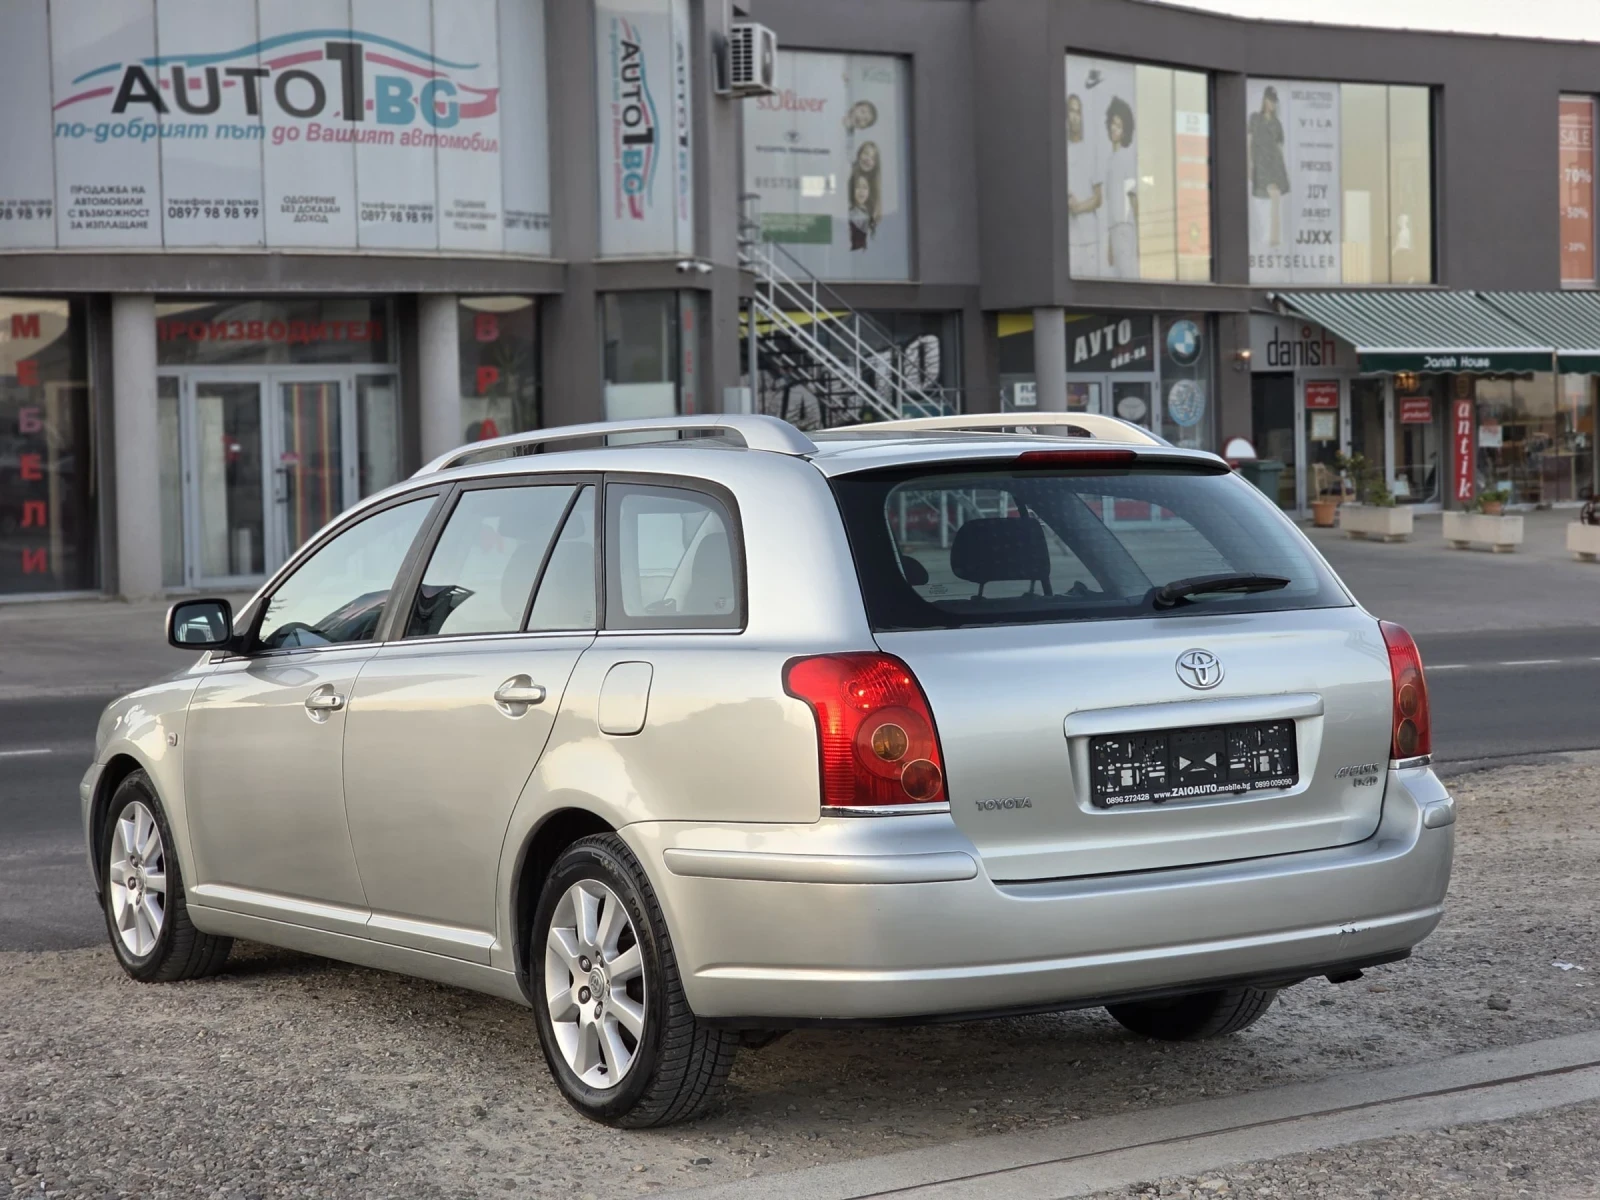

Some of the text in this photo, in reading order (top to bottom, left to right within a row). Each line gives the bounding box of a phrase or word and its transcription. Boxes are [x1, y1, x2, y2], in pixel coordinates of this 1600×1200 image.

[54, 117, 499, 153] по-добрият път до Вашият автомобил
[1560, 129, 1590, 146] SALE
[70, 185, 146, 195] ПРОДАЖБА НА
[73, 196, 143, 207] АВТОМОБИЛИ
[78, 208, 150, 218] ВЪЗМОЖНОСТ
[167, 206, 259, 219] 0897 98 98 99
[361, 209, 386, 222] 0897
[70, 220, 149, 230] ЗА ИЗПЛАЩАНЕ
[1295, 229, 1333, 245] JJXX
[1249, 254, 1335, 269] BESTSELLER
[1266, 325, 1337, 367] danish
[975, 797, 1033, 811] TOYOTA
